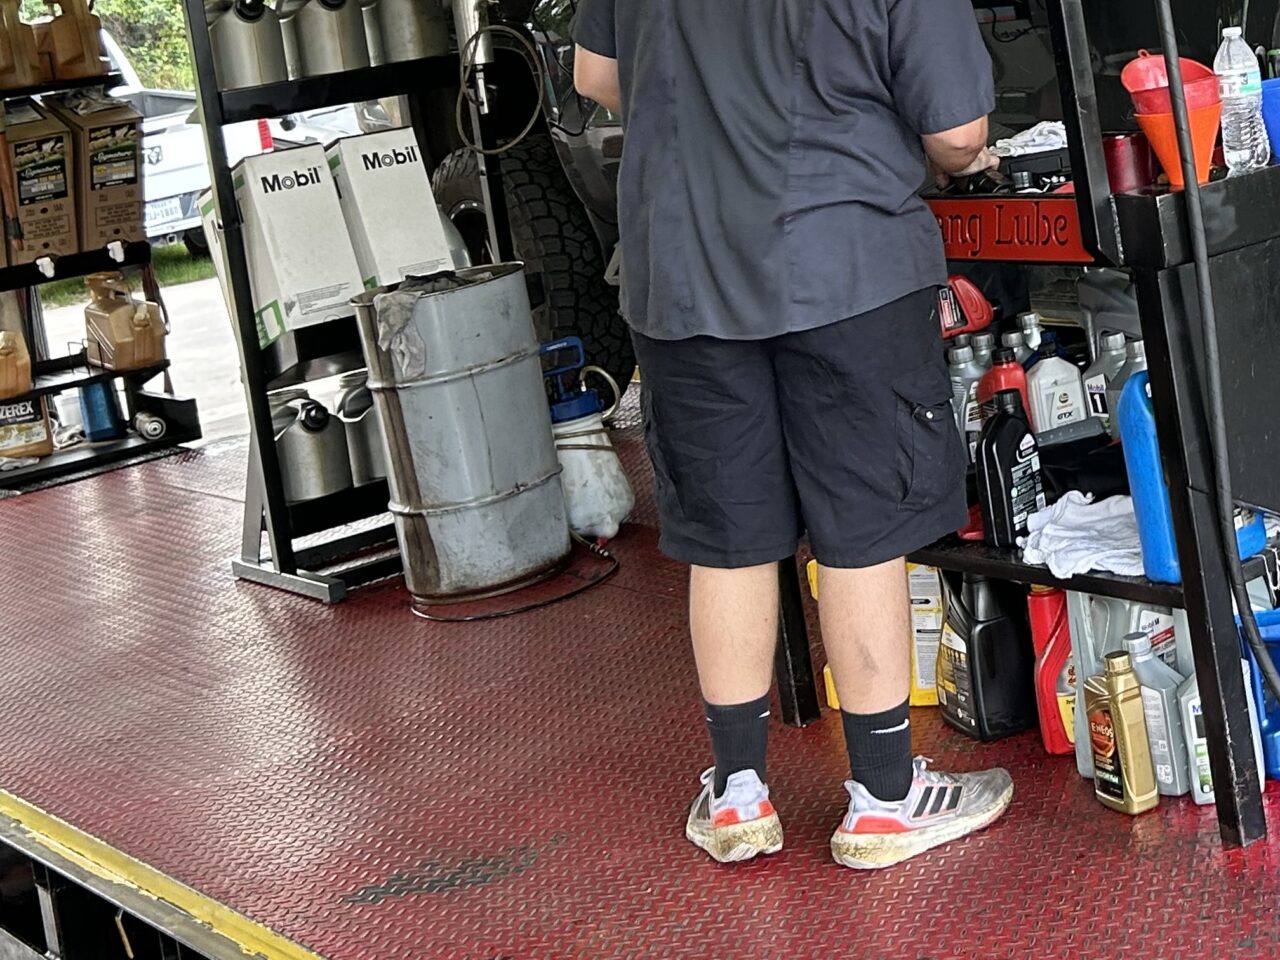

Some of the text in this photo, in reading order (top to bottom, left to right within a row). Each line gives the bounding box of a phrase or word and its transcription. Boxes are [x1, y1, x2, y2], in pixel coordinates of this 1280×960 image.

[362, 146, 418, 171] Mobil
[261, 167, 321, 194] Mobil
[994, 201, 1069, 246] Lube
[1087, 383, 1105, 392] Mobil
[0, 400, 34, 418] ZEREX
[1057, 410, 1073, 420] GTX
[1091, 722, 1114, 738] ENEOS
